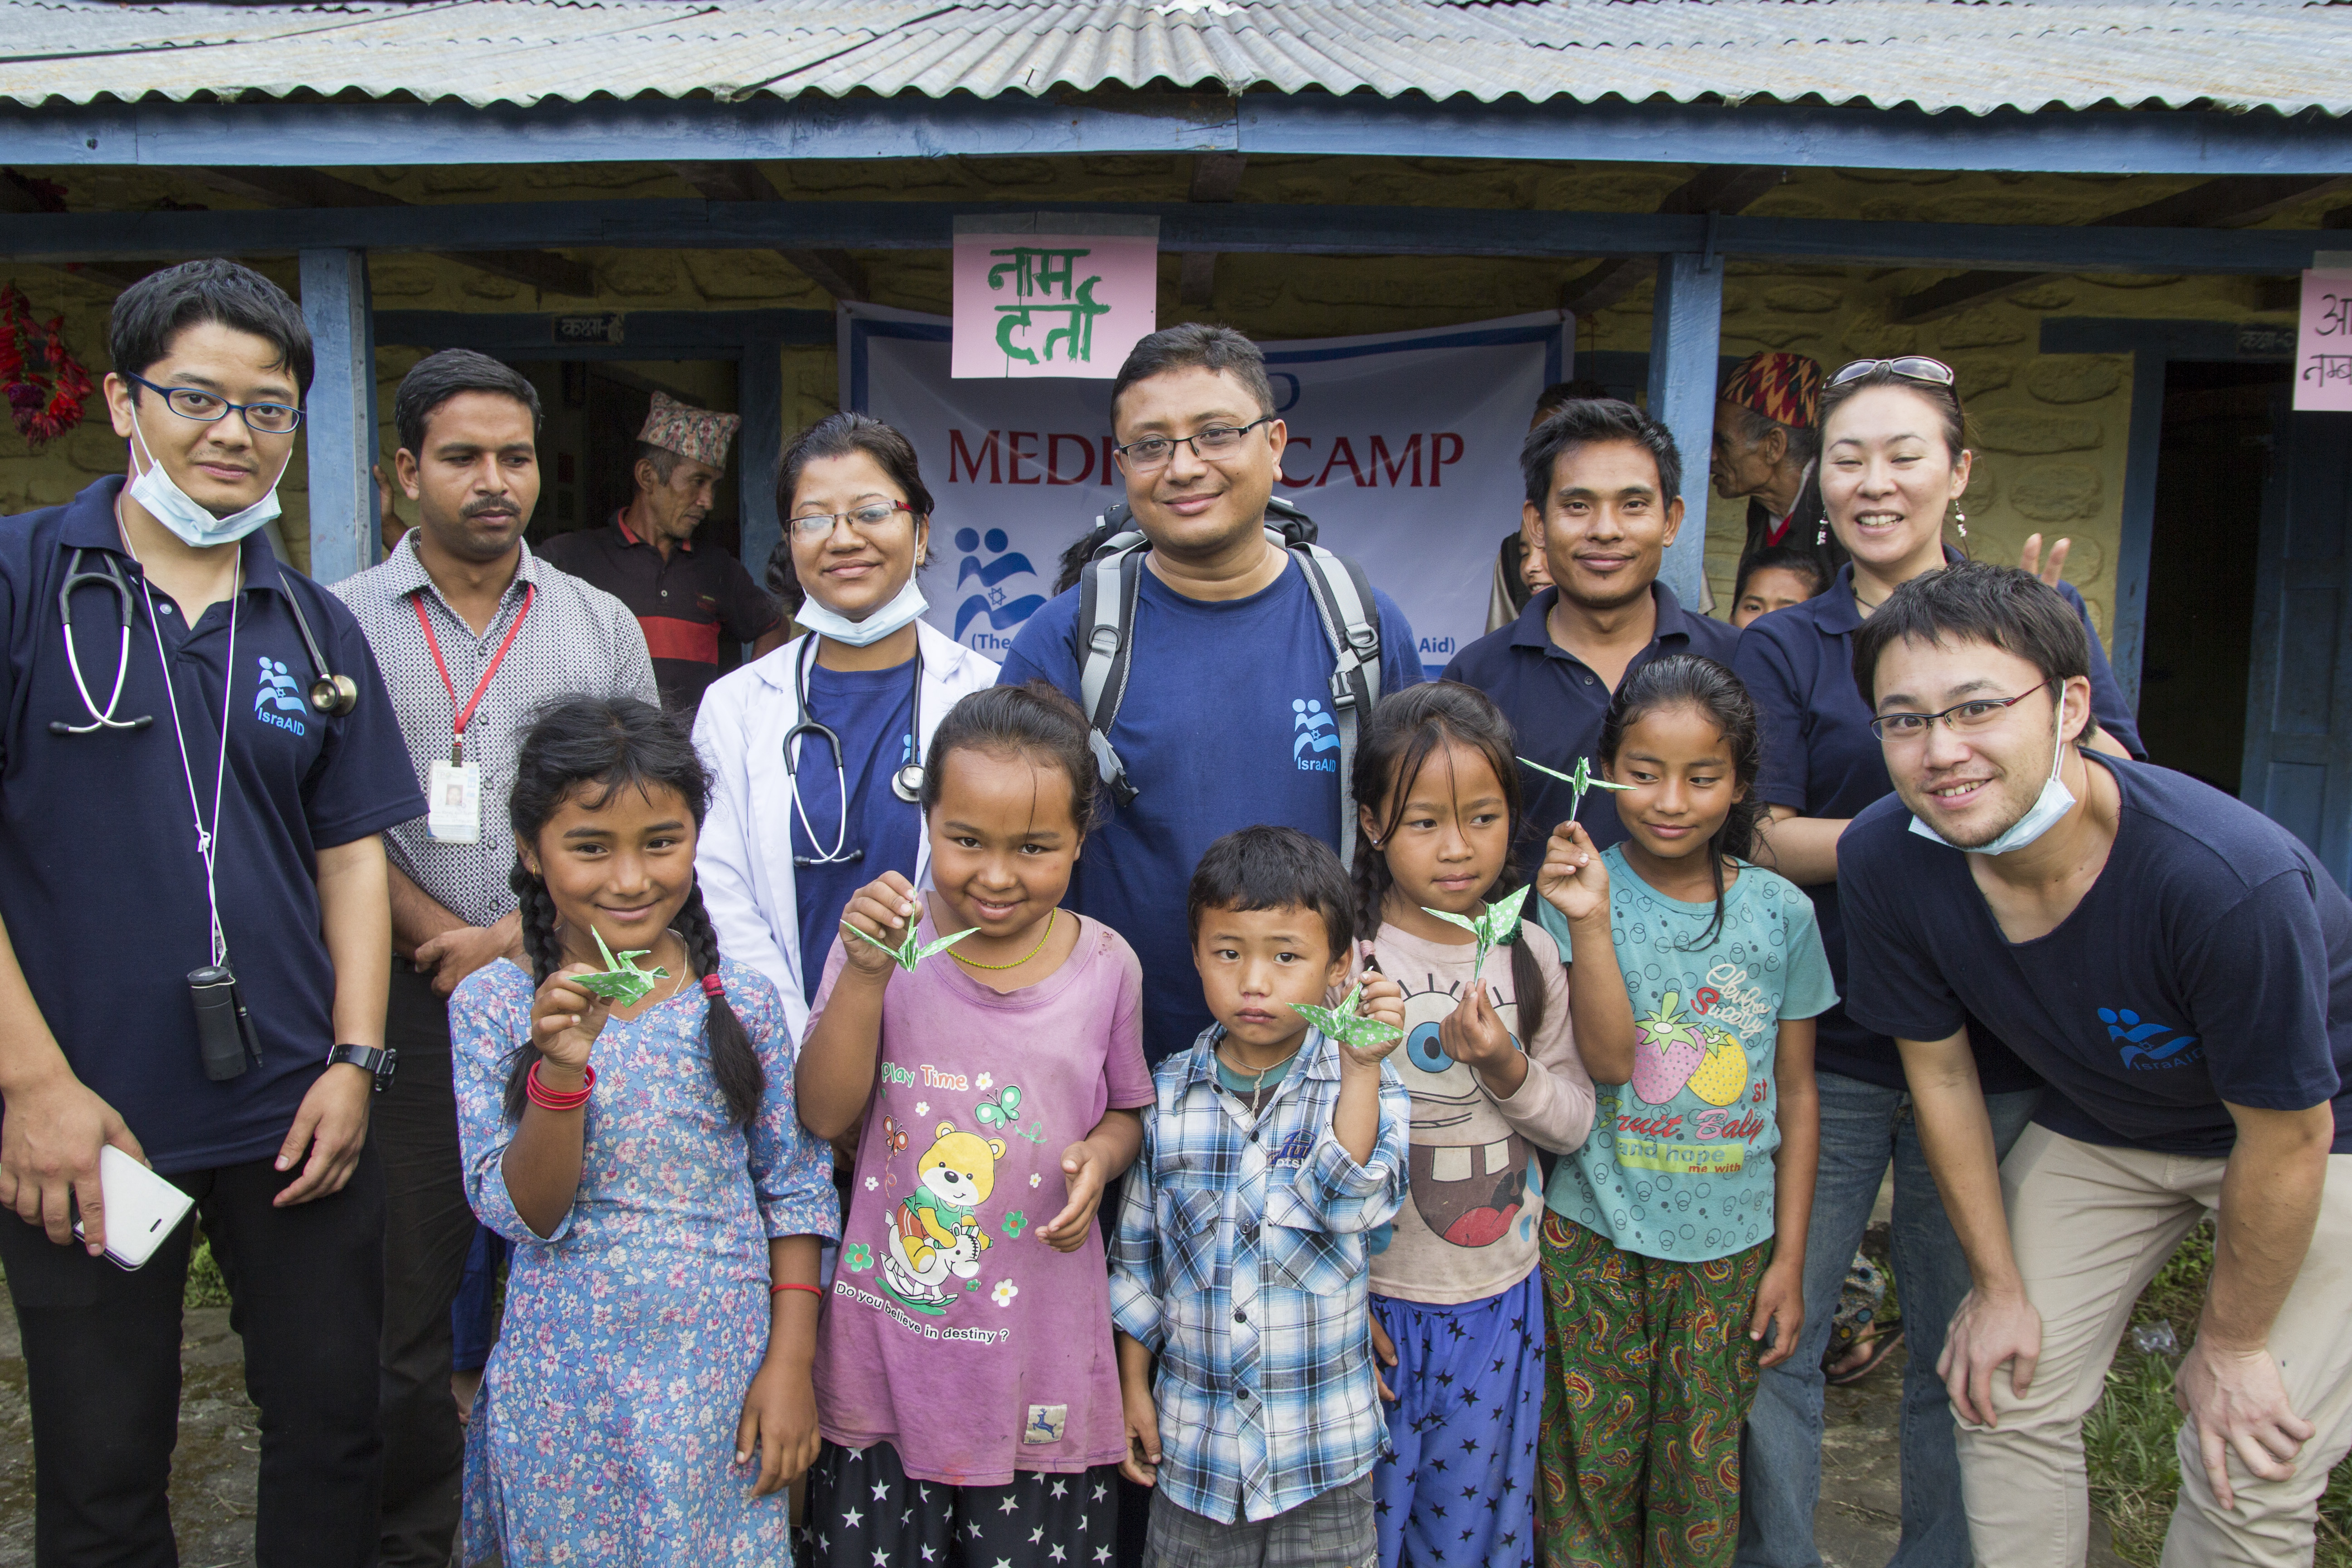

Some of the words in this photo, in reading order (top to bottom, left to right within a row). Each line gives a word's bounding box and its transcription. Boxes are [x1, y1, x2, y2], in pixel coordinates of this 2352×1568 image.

[988, 247, 1091, 300] नाम
[949, 429, 1113, 486] MEDI
[1278, 432, 1465, 488] CAMP
[971, 633, 1011, 652] (The
[1419, 637, 1455, 655] Aid)
[257, 707, 305, 736] IsraAID
[1297, 756, 1336, 773] IsraAID
[882, 1062, 915, 1088] Play
[921, 1065, 968, 1090] Time
[1616, 1141, 1658, 1160] and
[1665, 1144, 1725, 1165] hope
[1688, 1165, 1708, 1173] me
[1715, 1162, 1741, 1173] with
[837, 1283, 855, 1296] Do
[858, 1292, 882, 1308] you
[885, 1303, 921, 1333] believe
[926, 1326, 937, 1338] in
[943, 1328, 995, 1343] destiny
[1000, 1330, 1008, 1340] ?
